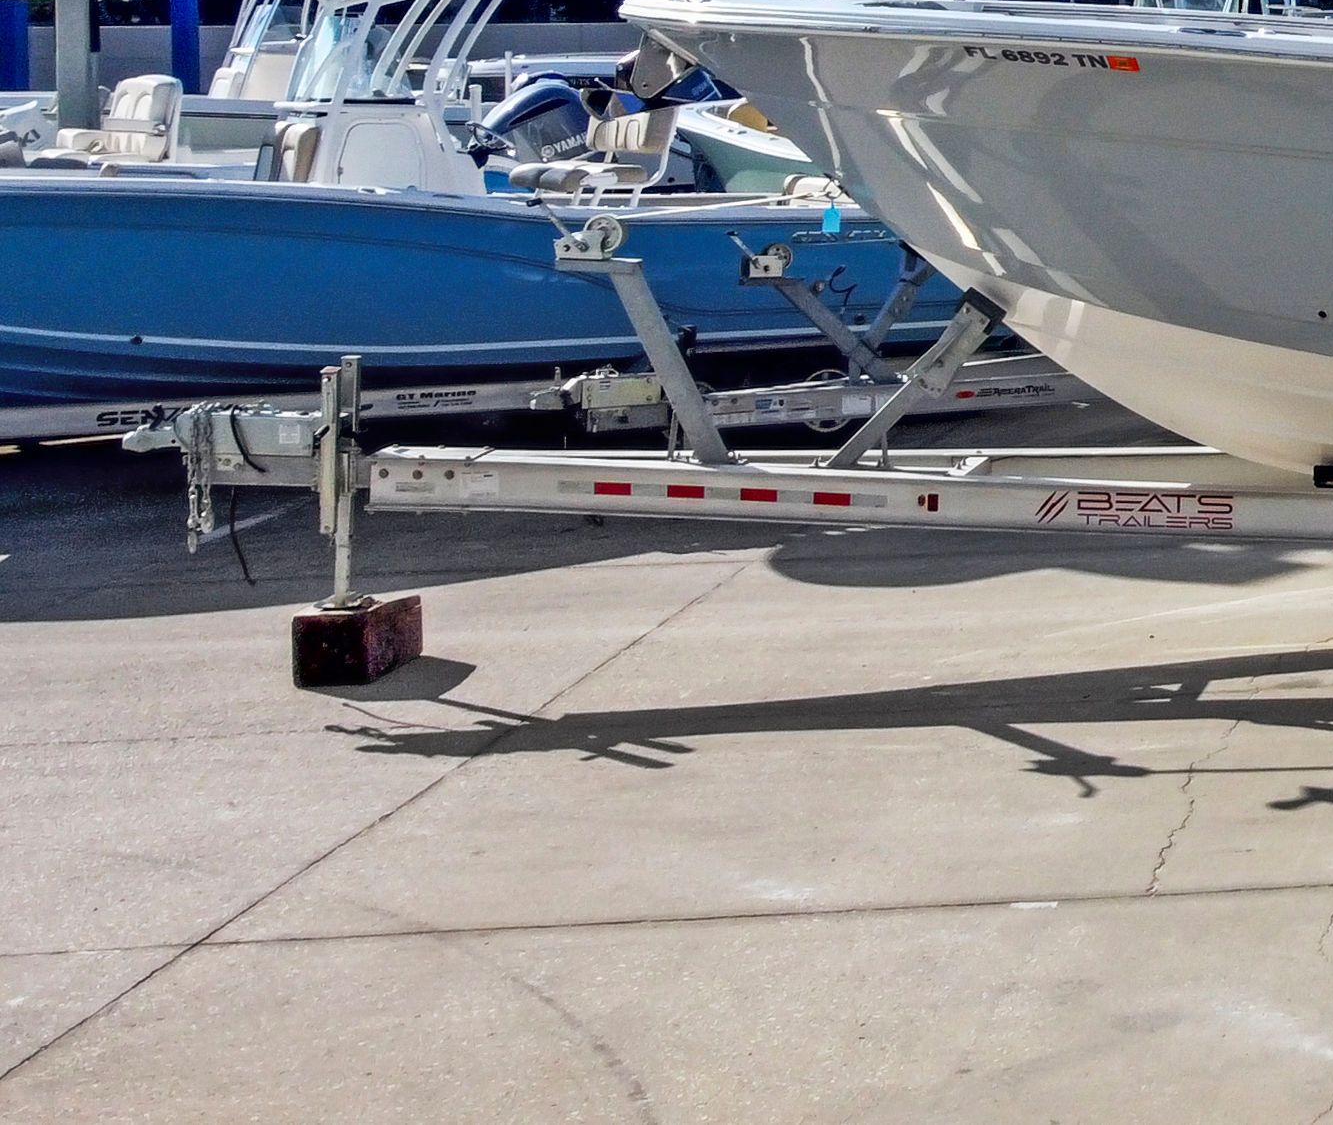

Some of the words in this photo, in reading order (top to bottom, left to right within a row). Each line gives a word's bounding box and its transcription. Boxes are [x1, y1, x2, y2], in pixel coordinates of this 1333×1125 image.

[963, 45, 998, 60] FL
[1001, 49, 1069, 67] 6892
[1072, 54, 1109, 69] TN
[420, 390, 476, 400] Marine
[1078, 491, 1234, 514] BEATS
[1078, 513, 1233, 530] TRAILERS
